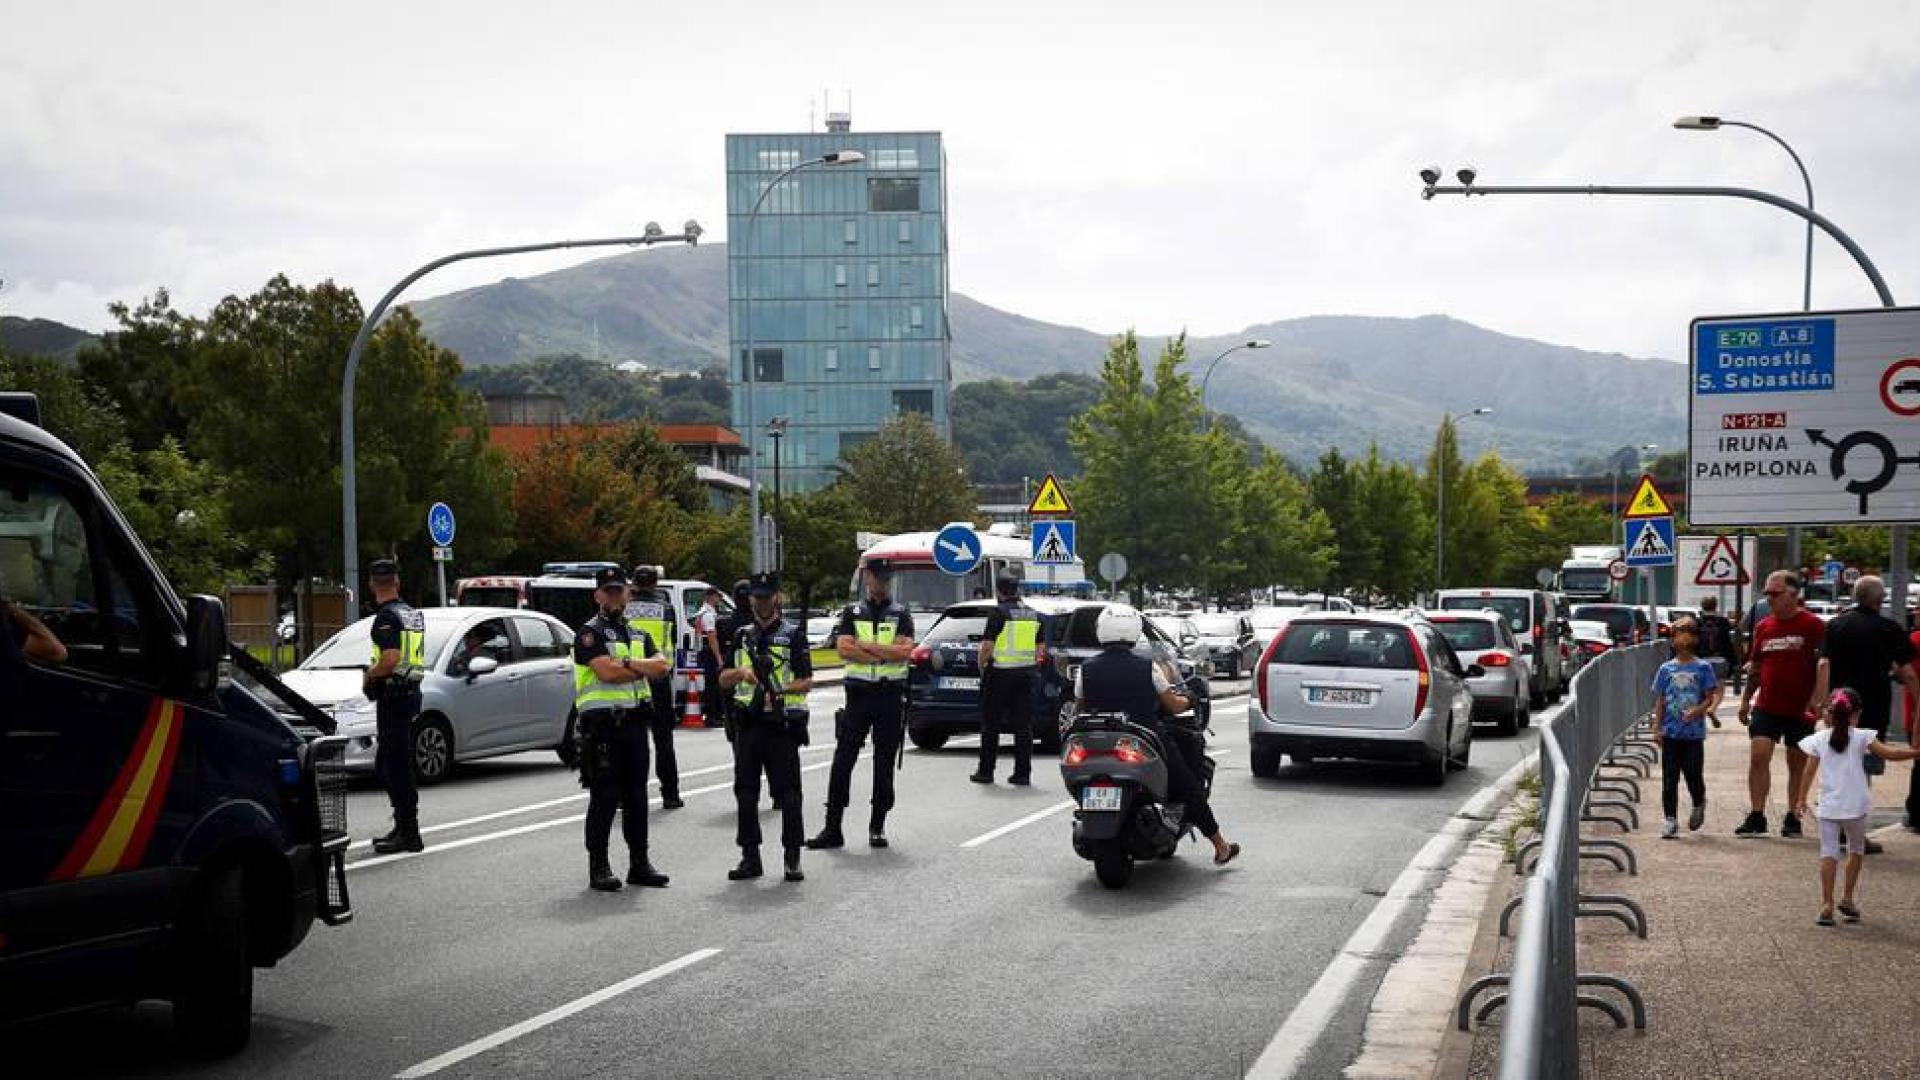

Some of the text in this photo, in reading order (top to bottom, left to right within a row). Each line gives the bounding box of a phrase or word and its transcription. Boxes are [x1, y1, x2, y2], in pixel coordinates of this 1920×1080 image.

[1720, 329, 1807, 345] E-70 A-8
[1719, 350, 1811, 368] Donostia
[1699, 370, 1833, 389] S. Sebastián
[1724, 414, 1785, 428] N-121-A
[1719, 433, 1788, 452] IRUÑA
[1696, 460, 1817, 477] PAMPLONA
